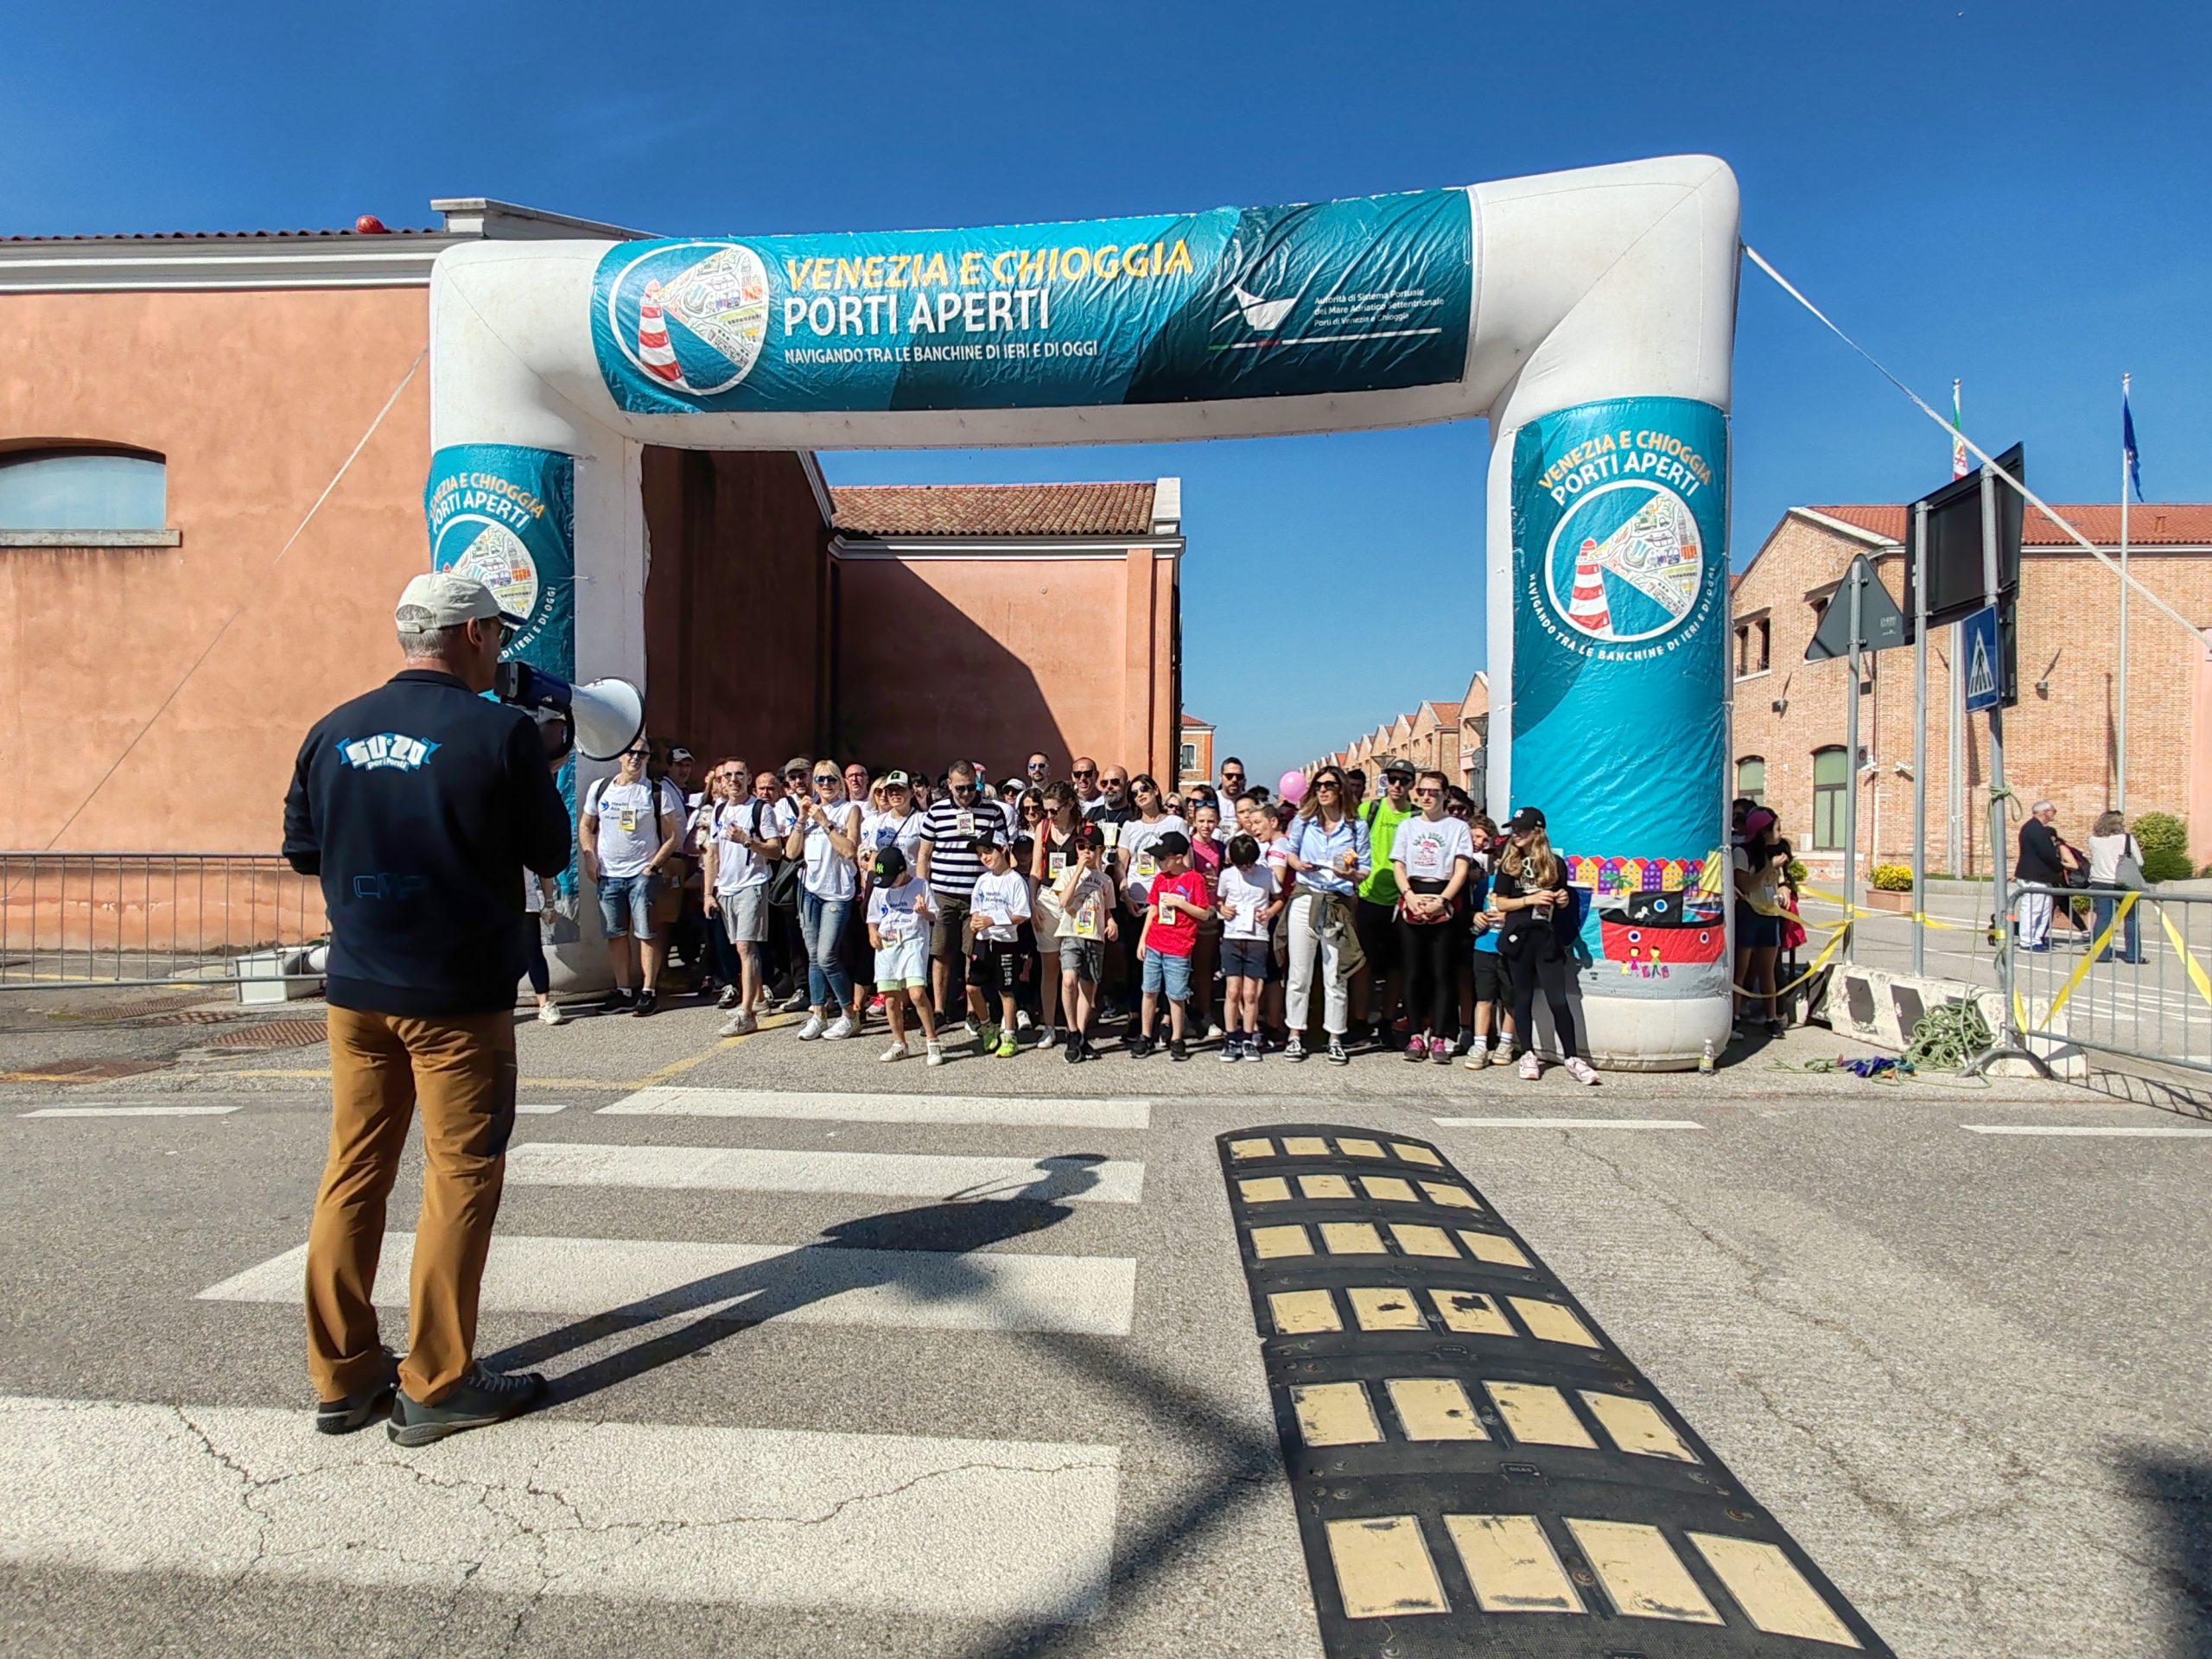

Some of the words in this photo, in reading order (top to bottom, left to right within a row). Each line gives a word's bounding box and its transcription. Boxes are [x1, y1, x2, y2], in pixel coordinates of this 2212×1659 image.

[787, 251, 950, 291] VENEZIA
[959, 252, 983, 286] E
[993, 238, 1194, 284] CHIOGGIA
[1357, 291, 1389, 302] Sistema
[1390, 288, 1425, 299] Portuale
[785, 294, 897, 336] PORTI
[909, 288, 1049, 334] APERTI
[1328, 304, 1349, 315] Mare
[1350, 302, 1386, 313] Adriatico
[1388, 296, 1445, 310] Settentrionale
[1314, 316, 1332, 327] Porti
[1341, 315, 1370, 325] Venezia
[785, 347, 863, 365] NAVIGANDO
[864, 346, 894, 364] TRA
[895, 346, 912, 362] LE
[914, 344, 983, 362] BANCHINE
[986, 344, 1000, 360] DI
[1003, 342, 1030, 359] IERI
[1033, 341, 1041, 358] E
[1044, 341, 1060, 358] DI
[1062, 340, 1097, 357] OGGI
[1539, 434, 1616, 490] VENEZIA
[1619, 429, 1631, 449] E
[1637, 429, 1712, 486] CHIOGGIA
[1550, 453, 1618, 506] PORTI
[1624, 451, 1700, 498] APERTI
[460, 472, 467, 489] E
[470, 472, 545, 518] CHIOGGIA
[463, 490, 531, 529] APERTI
[1701, 598, 1712, 613] DI
[501, 646, 514, 658] DI
[514, 632, 536, 652] IERI
[532, 625, 542, 634] E
[537, 613, 550, 626] DI
[544, 586, 556, 612] OGGI
[1698, 613, 1706, 622] E
[1681, 620, 1700, 643] IERI
[1554, 632, 1576, 652] TRA
[1579, 645, 1594, 658] LE
[1667, 638, 1681, 652] DI
[1598, 646, 1665, 662] BANCHINE
[366, 760, 384, 770] per
[386, 757, 409, 769] Ponti
